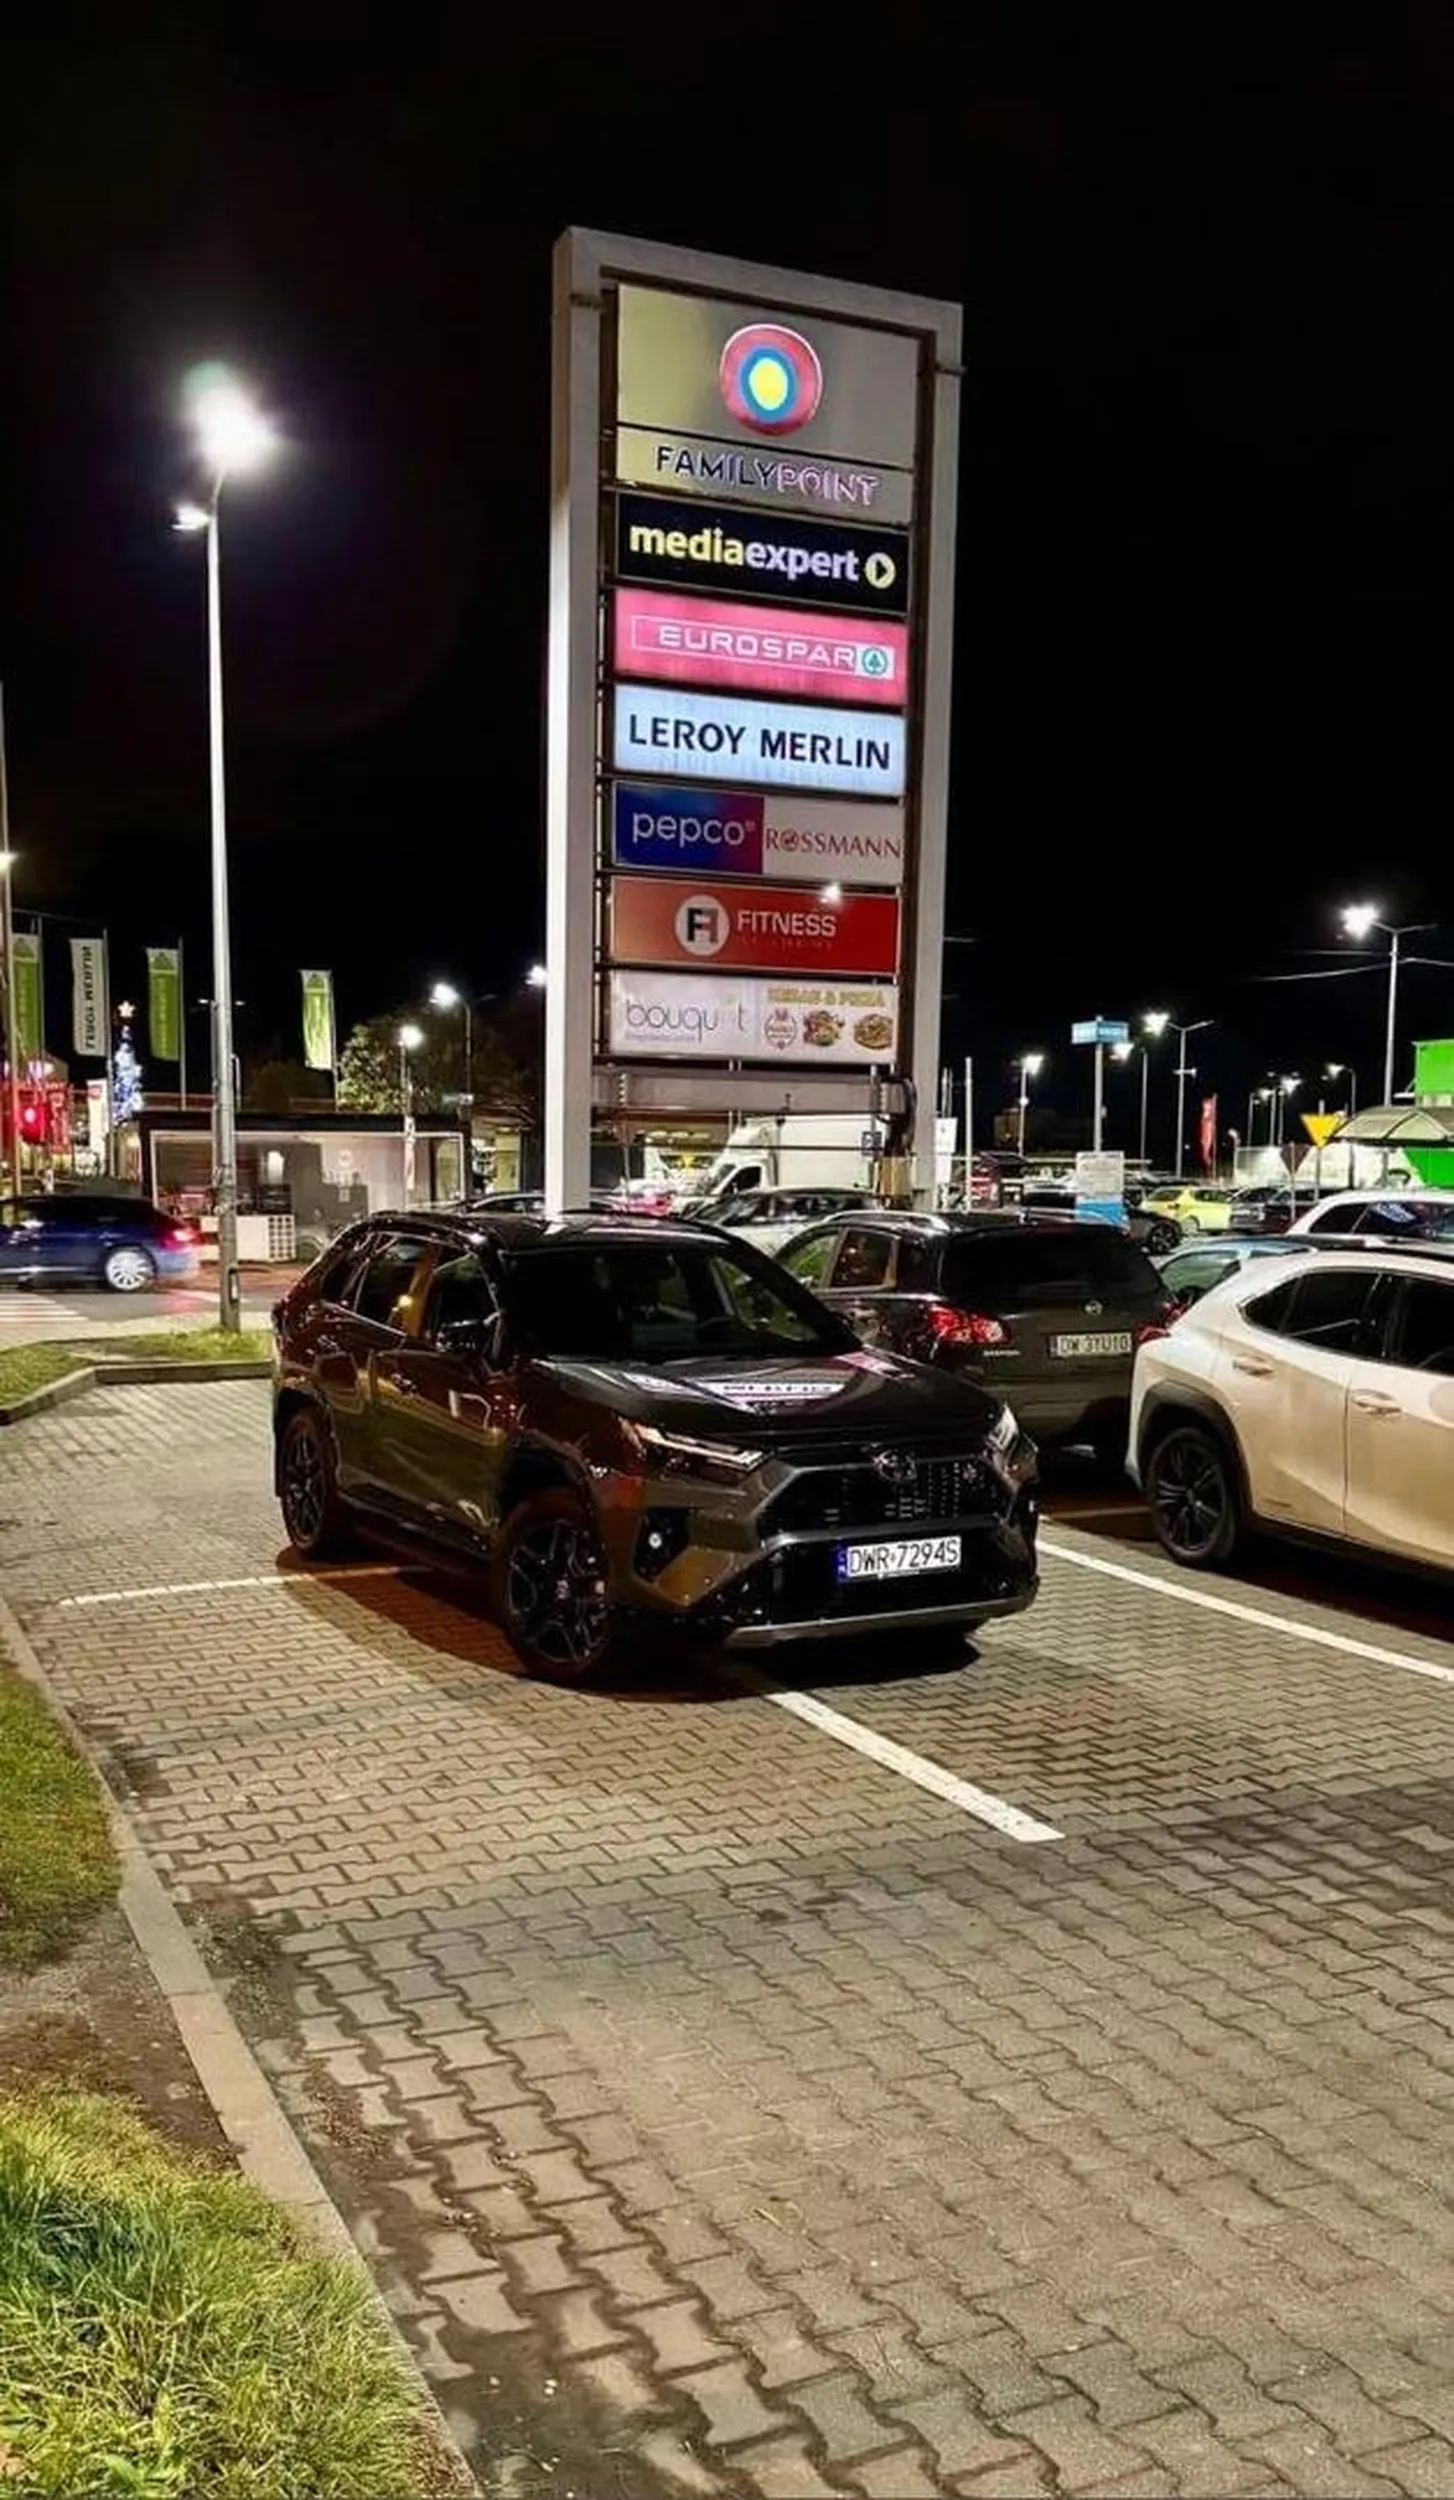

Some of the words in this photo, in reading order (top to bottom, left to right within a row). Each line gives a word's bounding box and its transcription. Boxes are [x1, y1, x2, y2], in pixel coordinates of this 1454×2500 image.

[629, 523, 859, 581] mediaexpert
[658, 625, 853, 667] EUROSPAR
[629, 715, 746, 754] LEROY
[760, 729, 890, 770] MERLIN
[737, 910, 836, 936] FITNESS
[850, 1547, 890, 1573] DWR
[897, 1540, 958, 1568] 7294S
